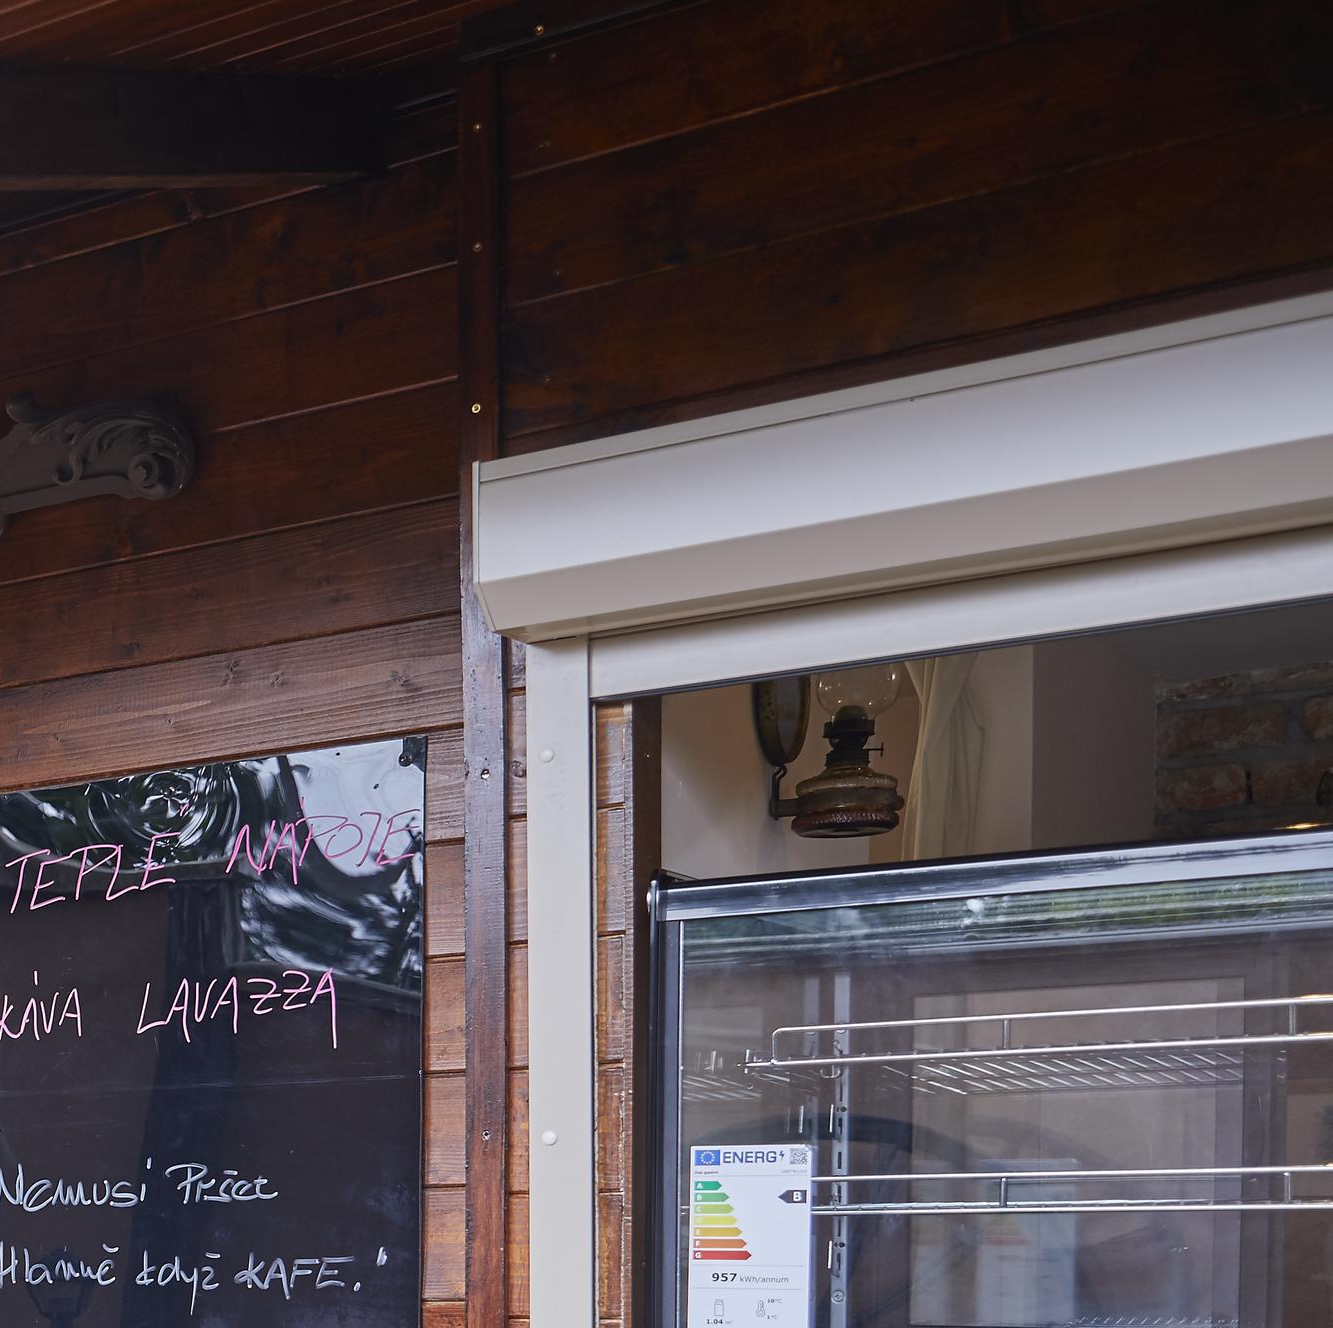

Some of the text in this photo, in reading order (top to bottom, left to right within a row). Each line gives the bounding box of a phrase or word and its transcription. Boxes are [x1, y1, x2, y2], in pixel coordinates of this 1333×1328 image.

[225, 795, 421, 886] NÁPOJE
[136, 967, 339, 1050] LAVAZZA
[793, 1191, 802, 1202] B
[712, 1272, 789, 1283] 957 kWh/annum
